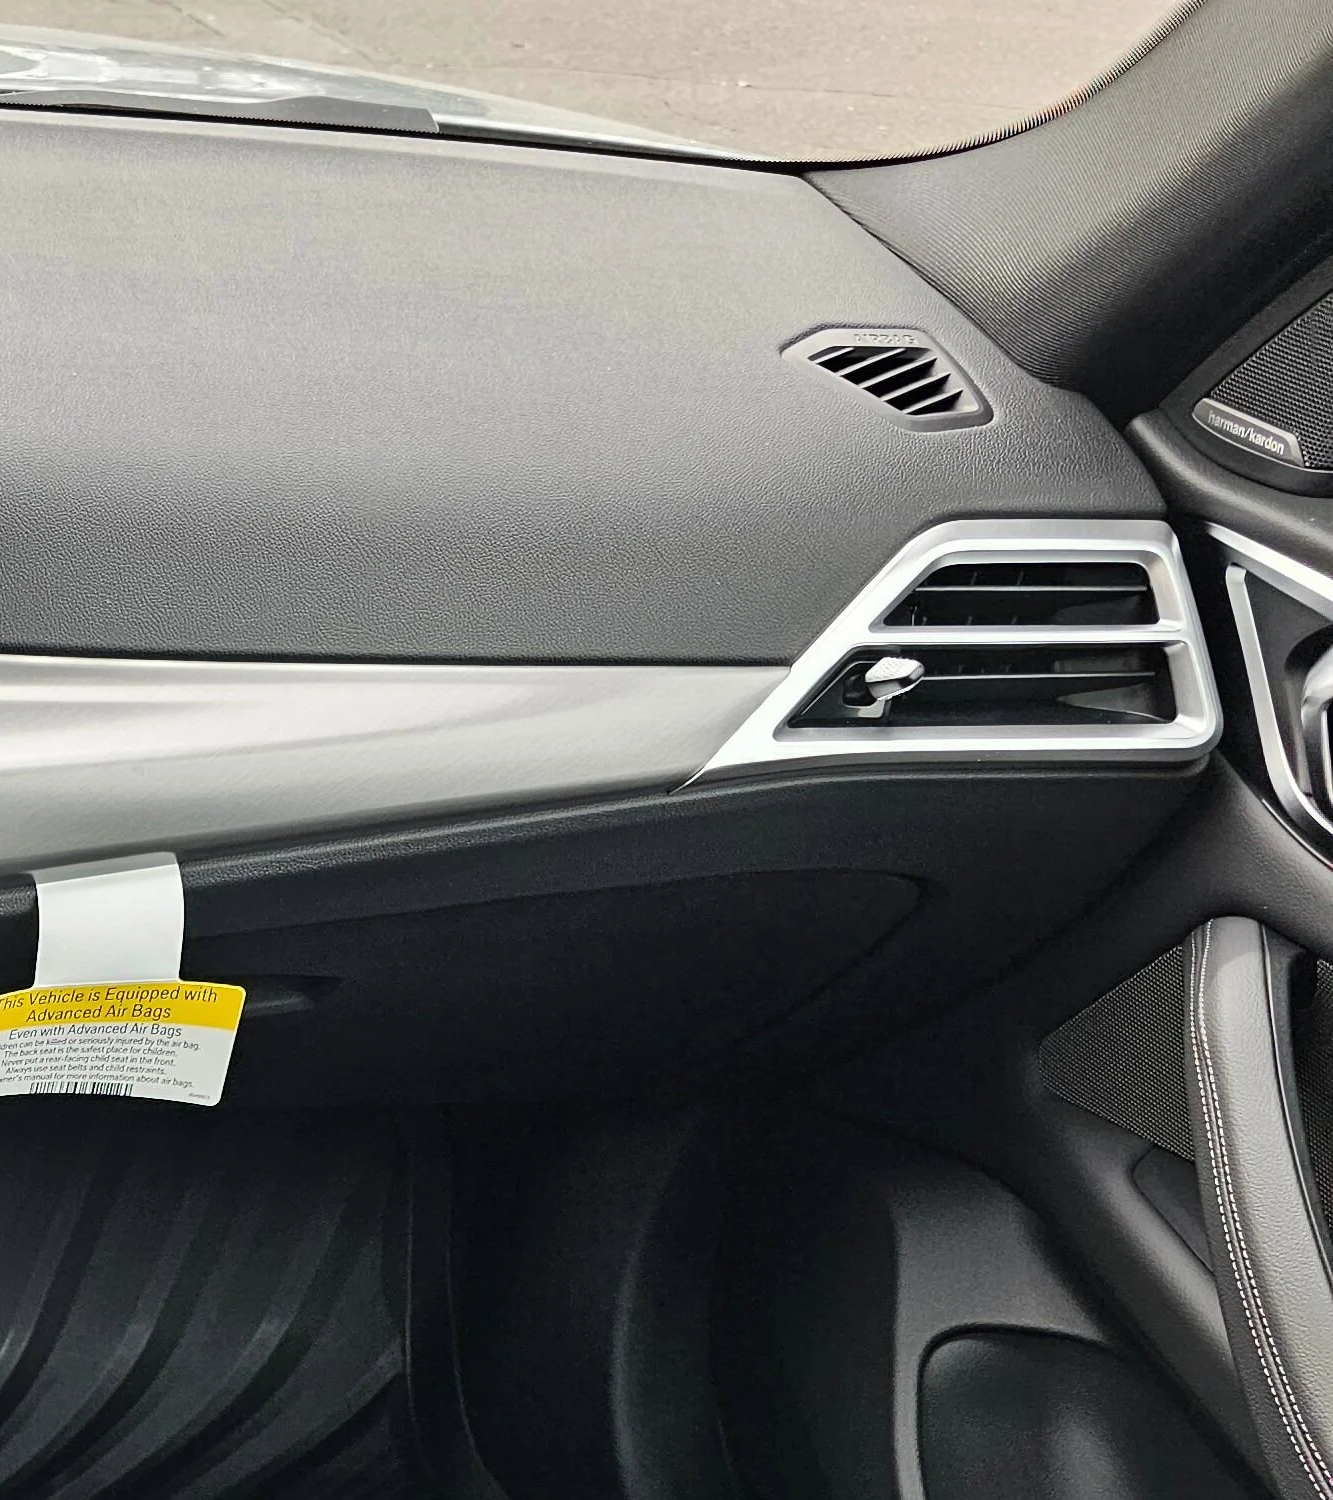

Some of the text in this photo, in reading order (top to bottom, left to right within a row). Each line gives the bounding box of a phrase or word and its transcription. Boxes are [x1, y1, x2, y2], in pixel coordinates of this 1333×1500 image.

[1207, 409, 1285, 456] harman/kardon
[28, 989, 85, 1006] Vehicle
[88, 988, 101, 1002] is
[104, 986, 181, 1004] Equipped
[184, 986, 218, 1003] with
[26, 1003, 172, 1023] Advanced Air Bags
[8, 1022, 182, 1041] Even with Advanced Air Bags
